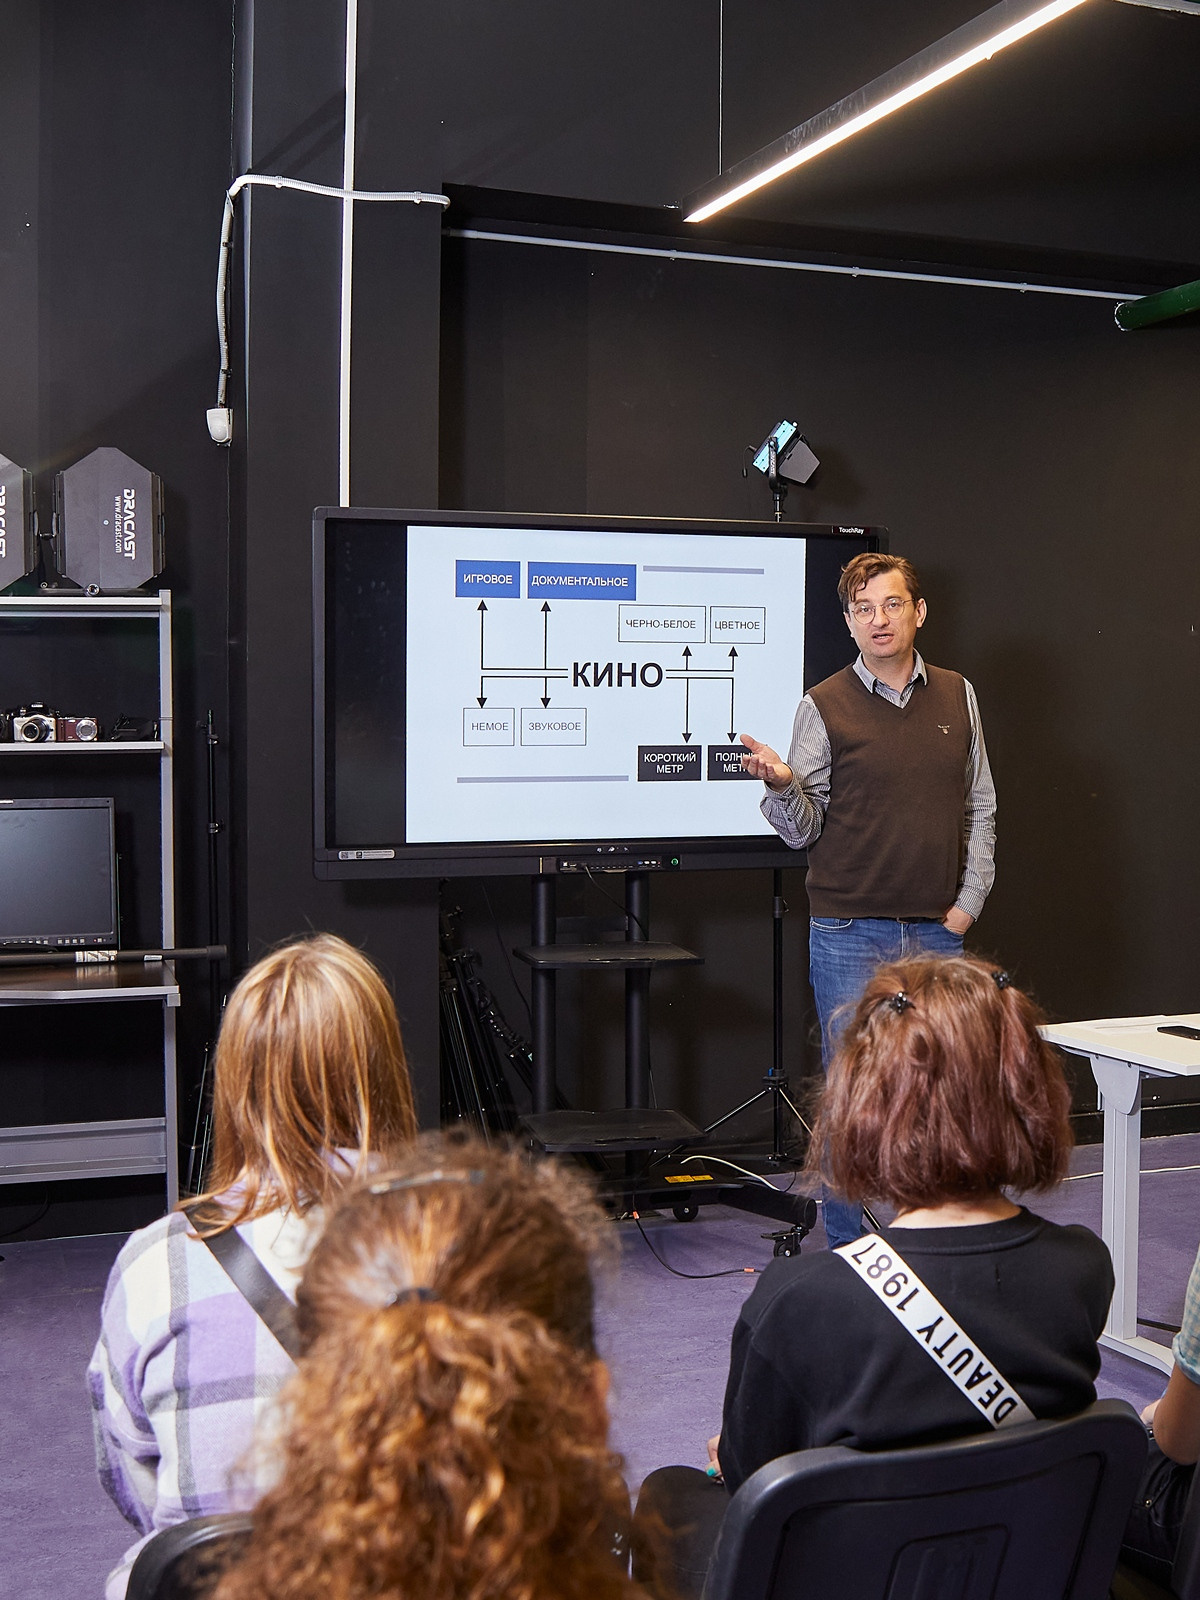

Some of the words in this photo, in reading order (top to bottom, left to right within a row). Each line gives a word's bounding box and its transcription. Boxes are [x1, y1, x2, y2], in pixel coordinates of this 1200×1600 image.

[114, 495, 123, 554] www.dracast.com
[123, 488, 136, 561] DRACAST
[463, 573, 513, 585] ИГРОВОЕ
[531, 575, 629, 587] ДОКУМЕНТАЛЬНОЕ
[625, 619, 696, 629] ЧЕРНО-БЕЛОЕ
[714, 620, 760, 631] ЦВЕТНОЕ
[572, 661, 664, 688] КИНО
[471, 722, 509, 731] НЕМОЕ
[528, 722, 582, 731] ЗВУКОВОЕ
[644, 751, 697, 763] КОРОТКИЙ
[715, 752, 754, 762] ПОЛН
[656, 764, 684, 774] МЕТР
[850, 1241, 919, 1312] 1987
[916, 1315, 1019, 1425] DEAUTY
